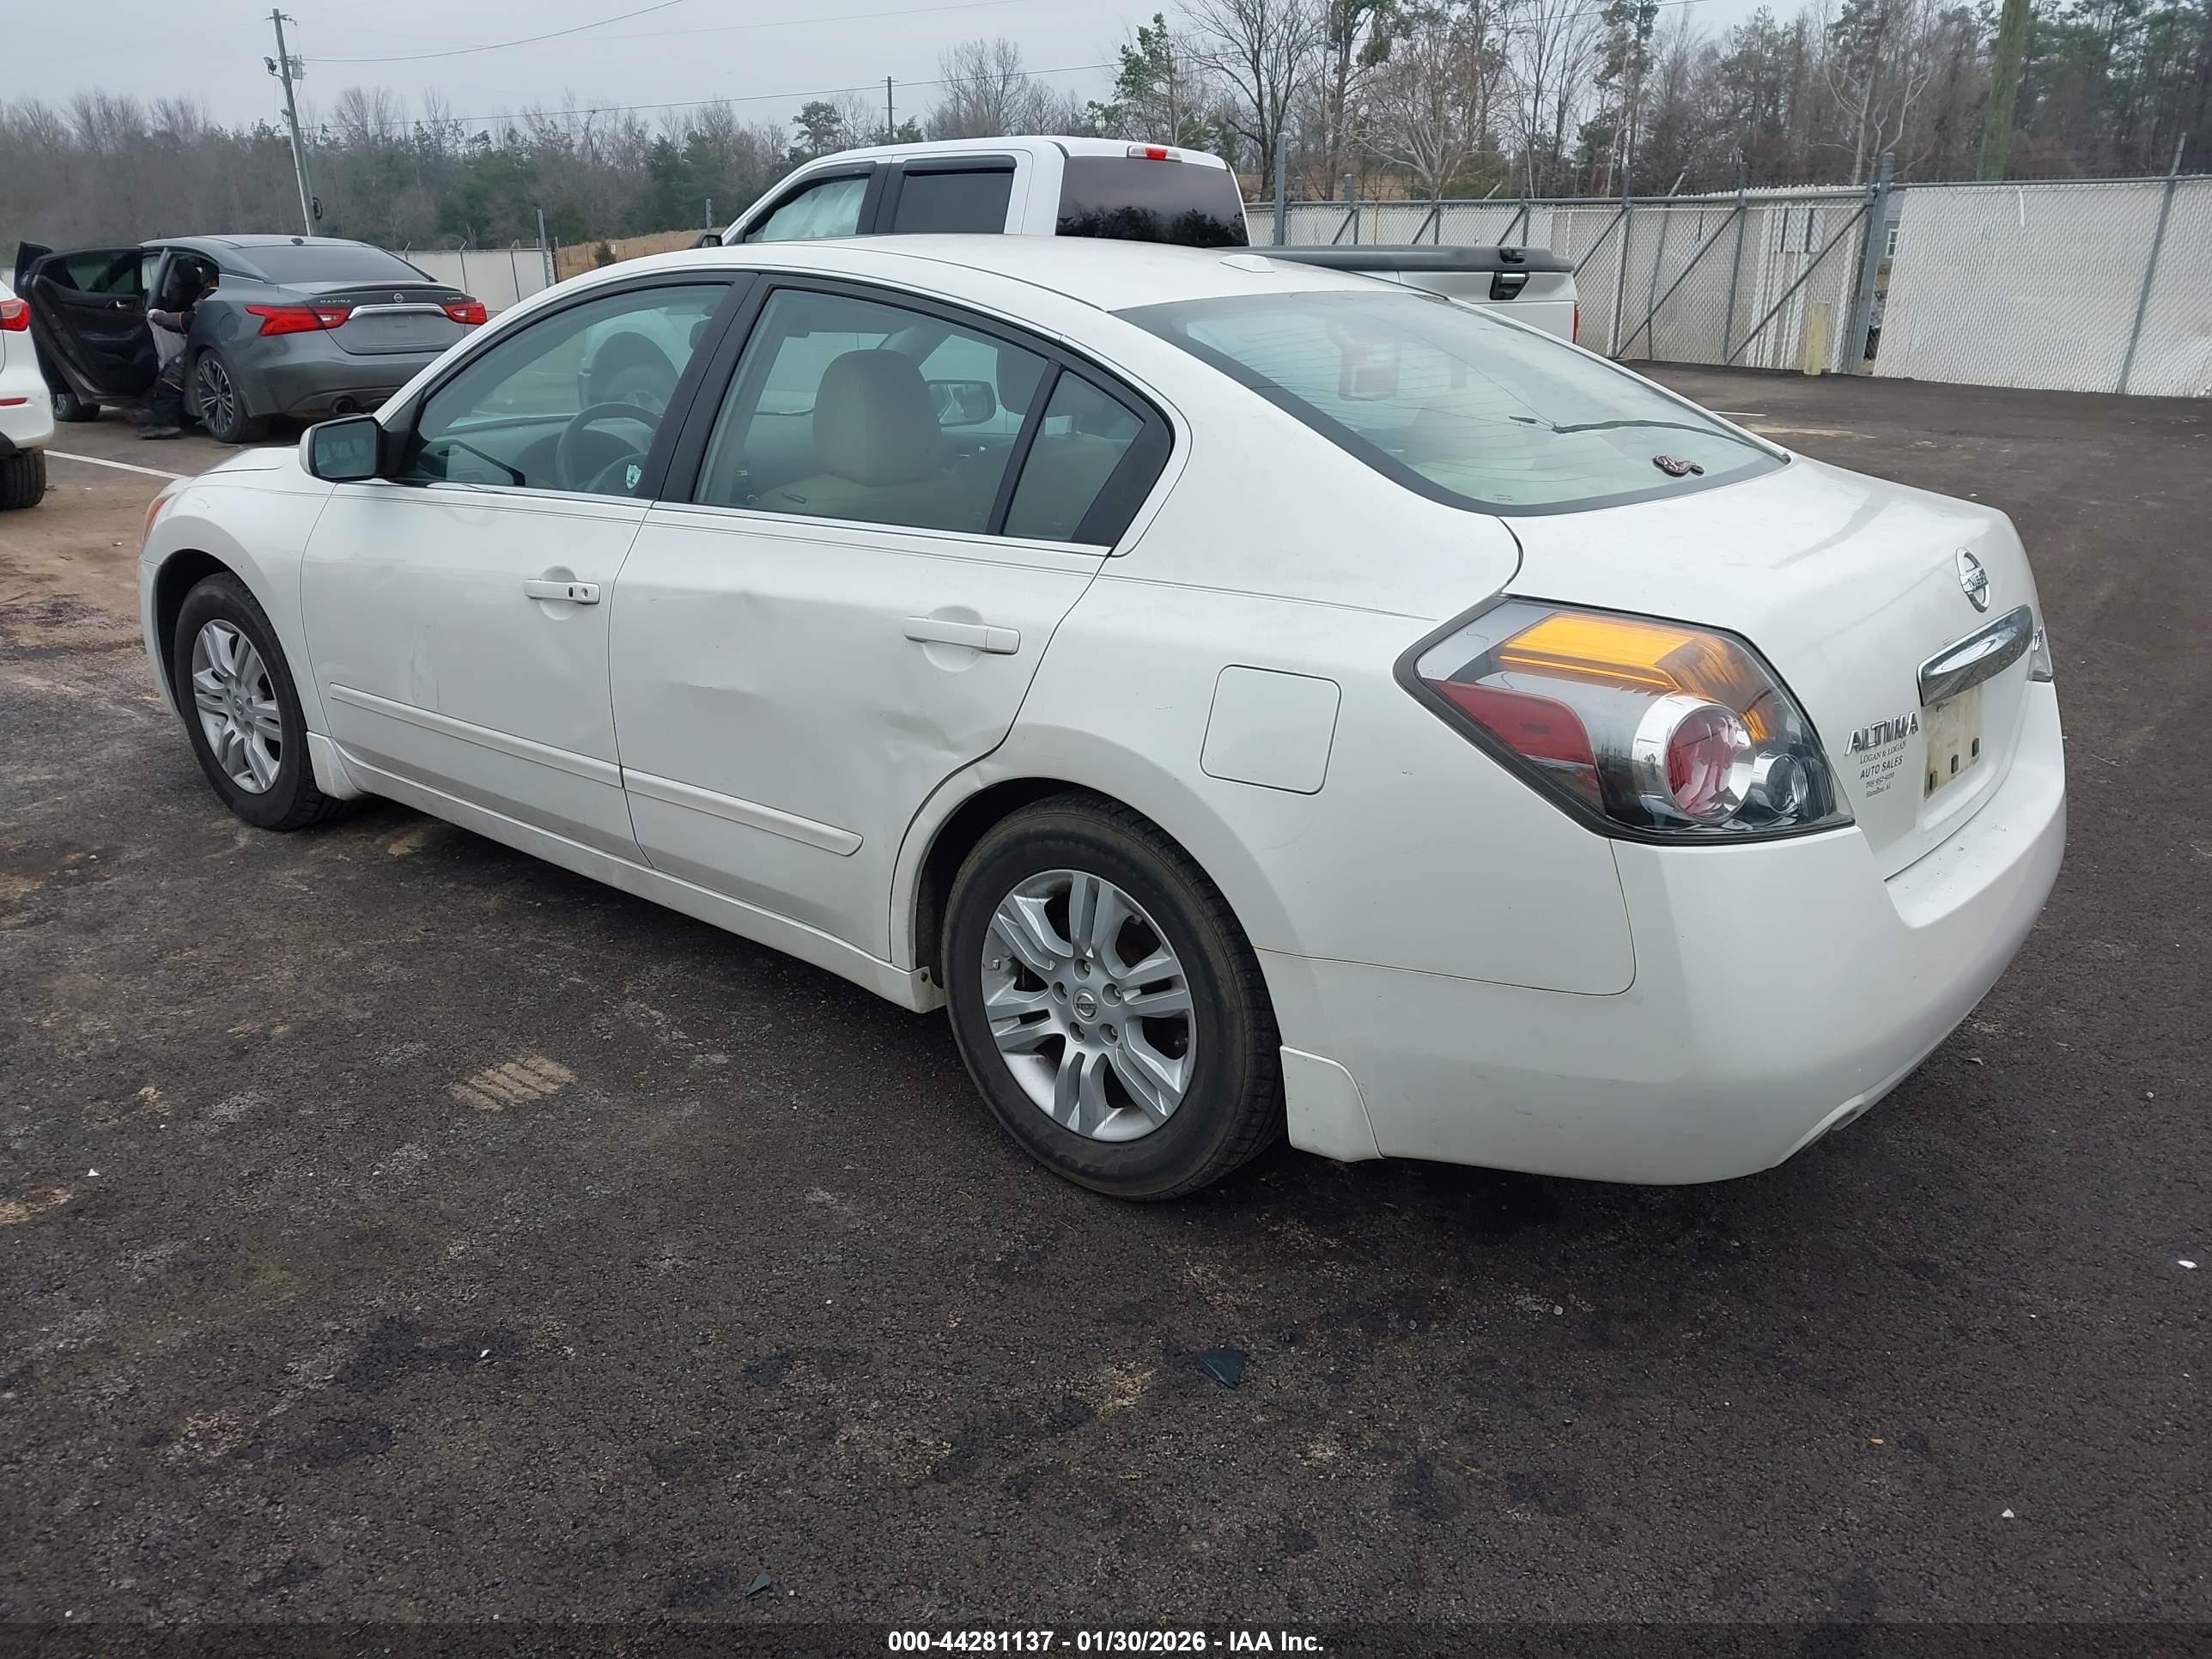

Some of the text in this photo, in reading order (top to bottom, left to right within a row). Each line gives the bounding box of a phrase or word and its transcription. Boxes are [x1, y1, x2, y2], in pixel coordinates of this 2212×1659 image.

[1844, 711, 1918, 756] ALTIMA
[1860, 750, 1881, 764] LOGAN
[1887, 738, 1907, 755] LOGAN
[1860, 755, 1903, 780] AUTO SALES
